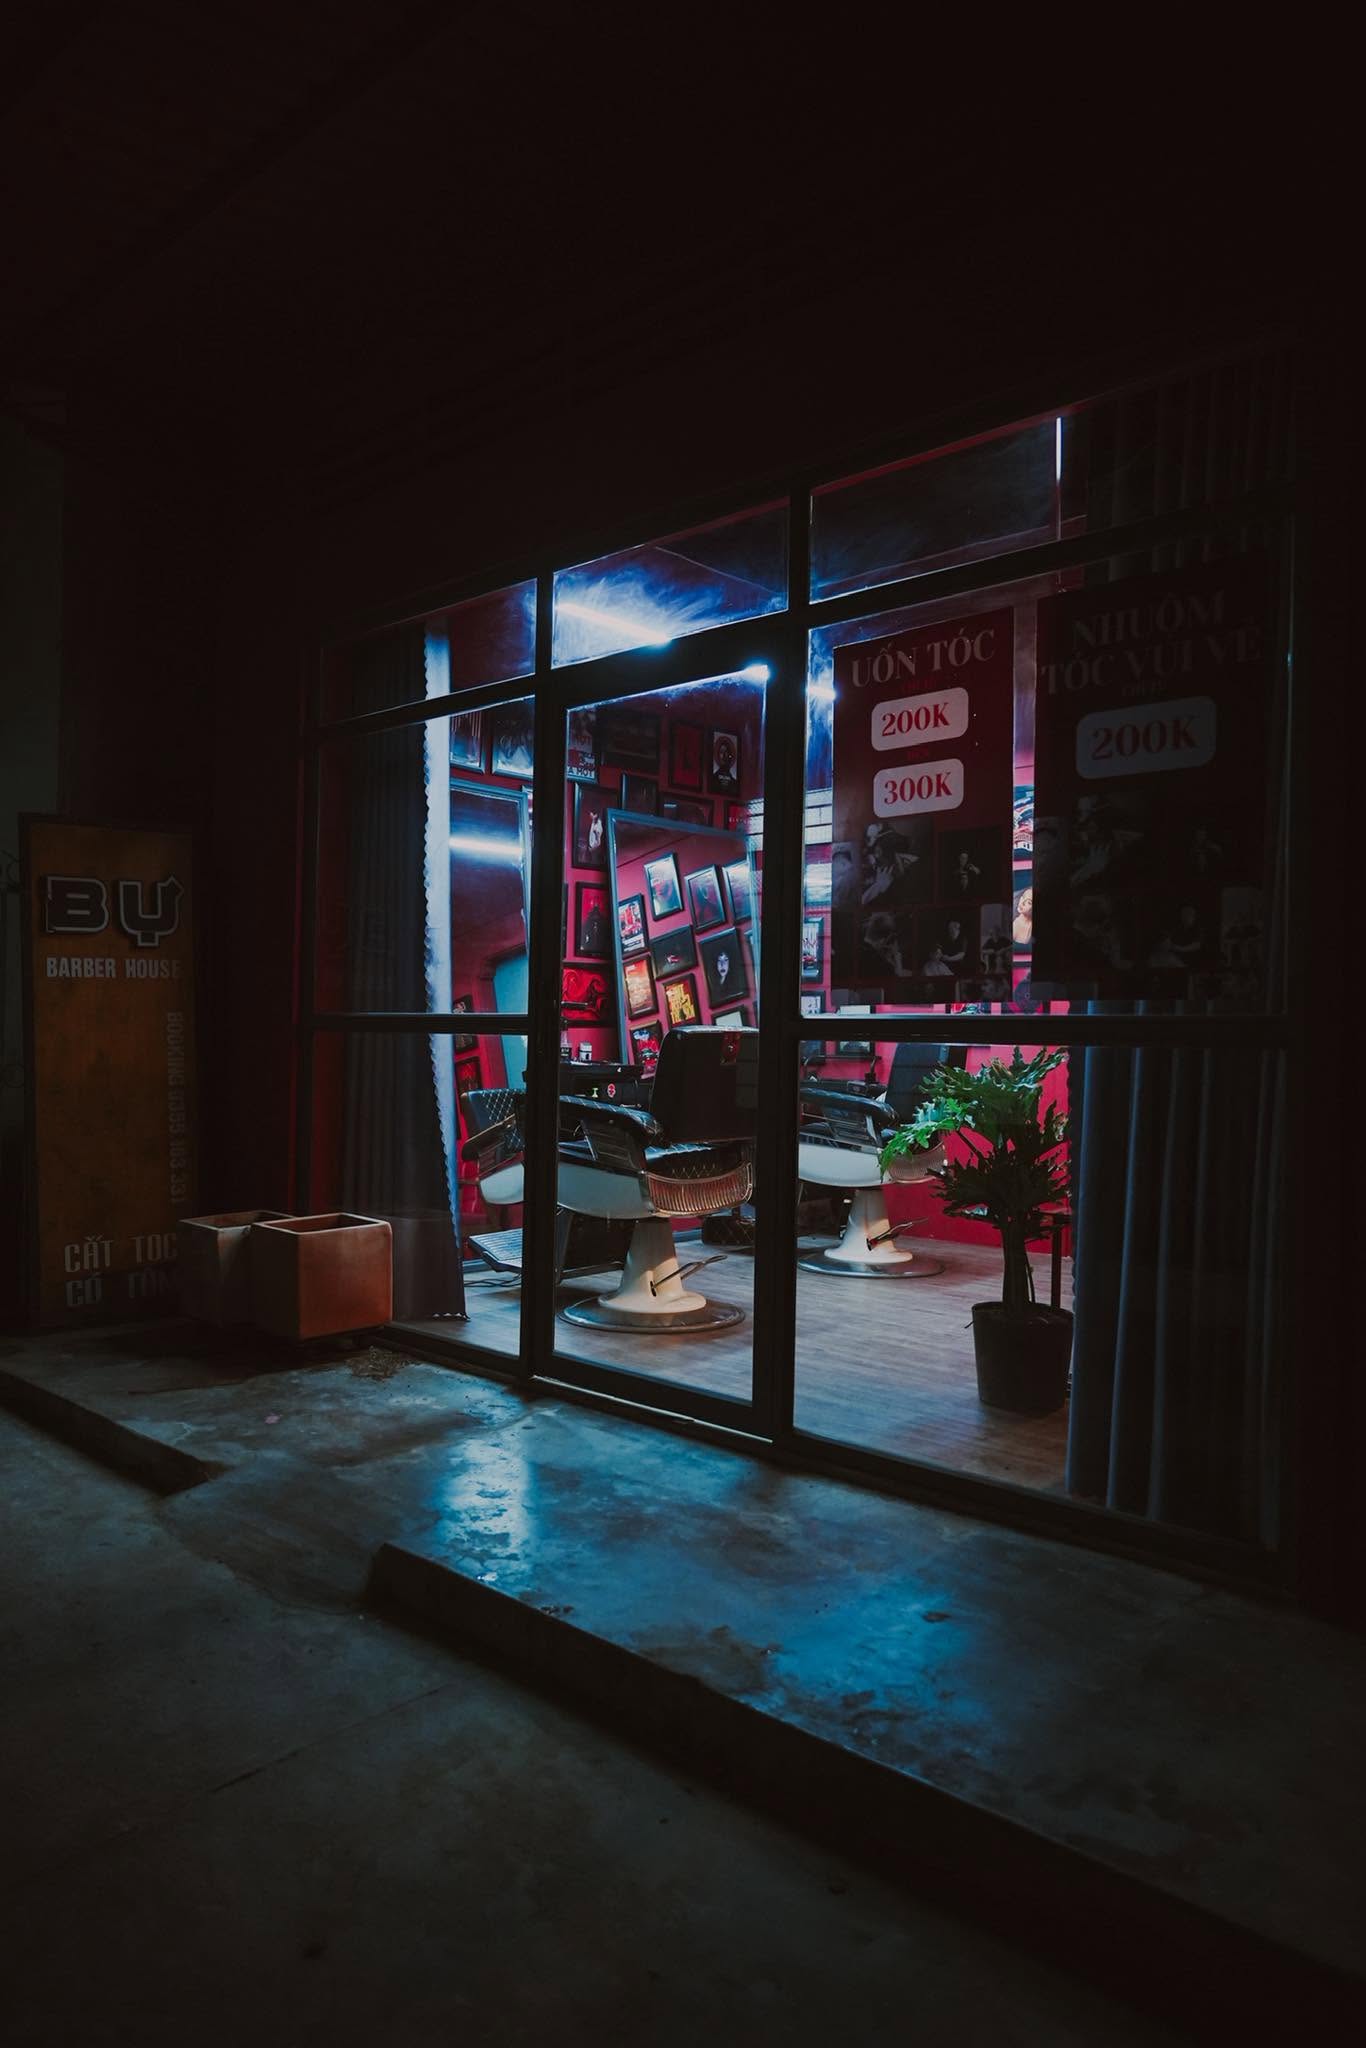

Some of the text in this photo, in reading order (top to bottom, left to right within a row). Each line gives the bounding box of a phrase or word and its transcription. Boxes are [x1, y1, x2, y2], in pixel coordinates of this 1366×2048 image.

[851, 628, 995, 687] UỐN TÓC
[881, 702, 950, 737] 200K
[1091, 714, 1201, 761] 200K
[883, 772, 953, 805] 300K
[46, 957, 182, 979] BARBER HOUSE
